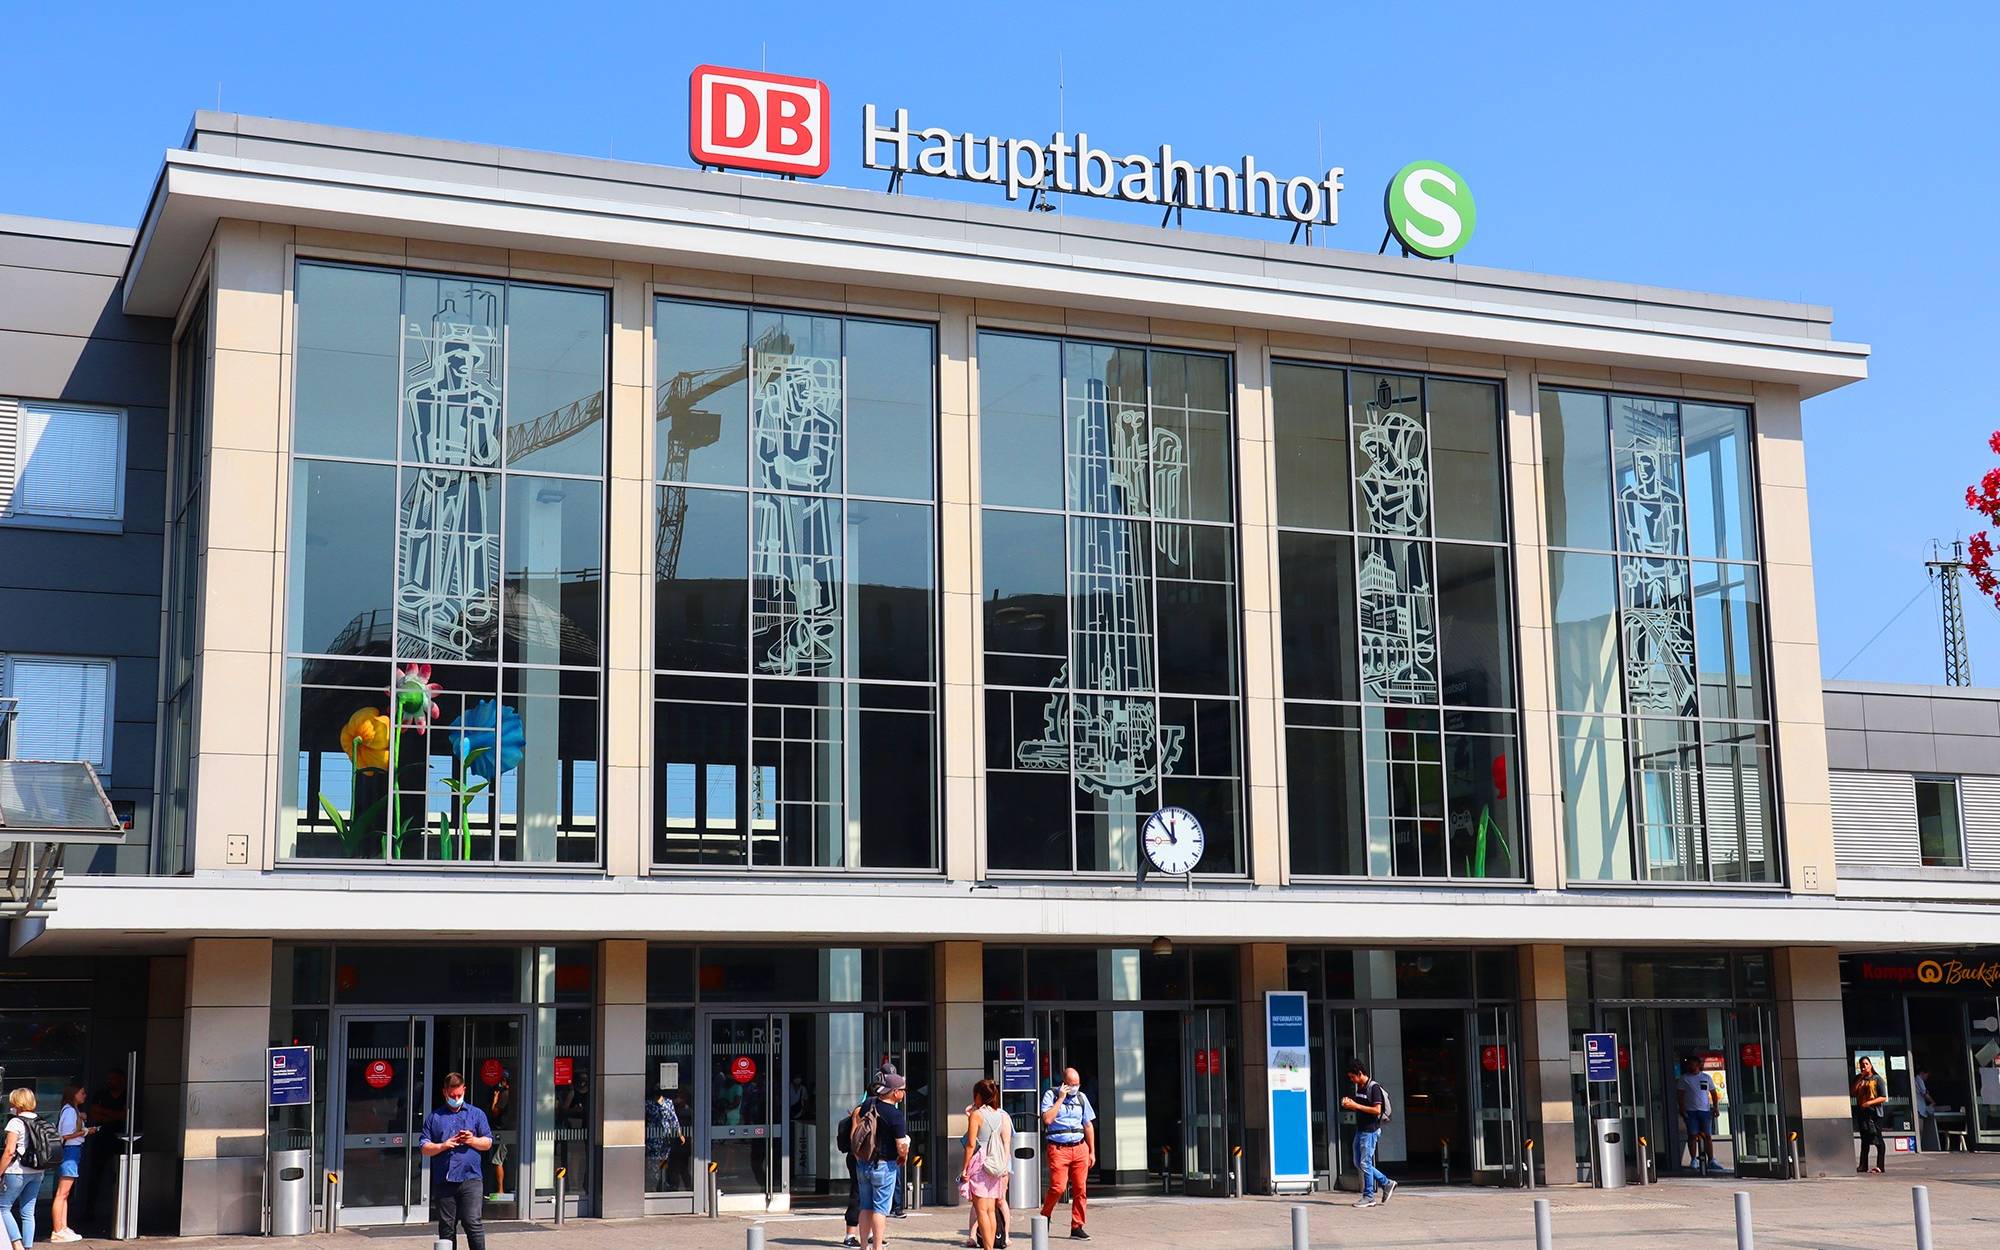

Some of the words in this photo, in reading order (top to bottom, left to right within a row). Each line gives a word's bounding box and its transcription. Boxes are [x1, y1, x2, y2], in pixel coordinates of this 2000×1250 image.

[711, 82, 813, 156] DB
[862, 103, 1344, 226] Hauptbahnhof
[1403, 168, 1462, 248] S
